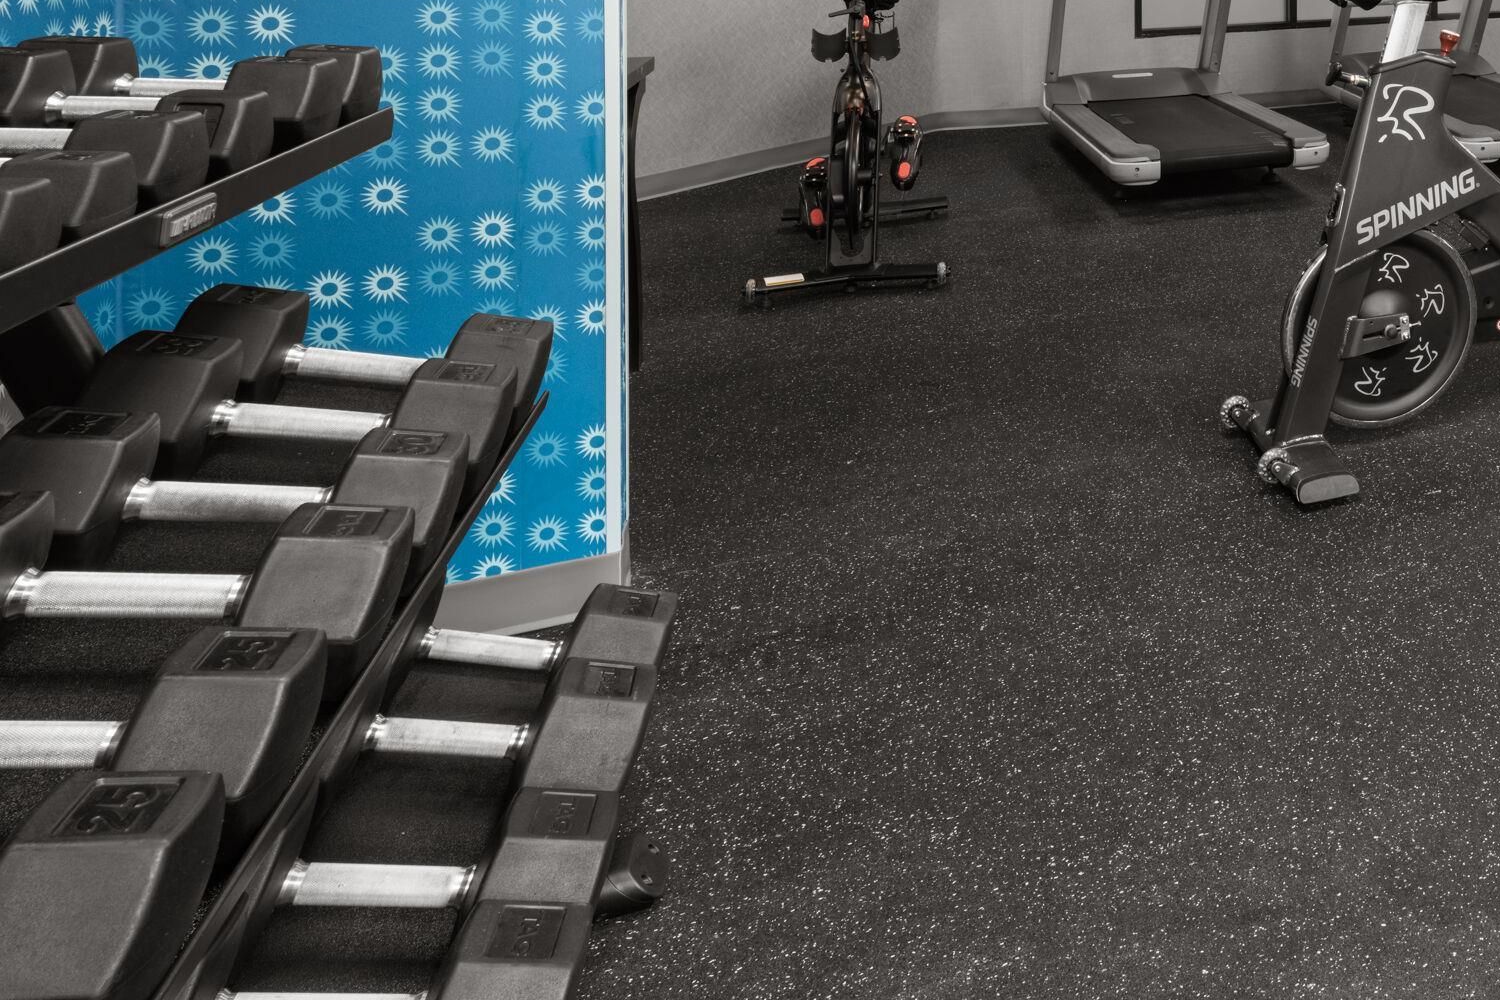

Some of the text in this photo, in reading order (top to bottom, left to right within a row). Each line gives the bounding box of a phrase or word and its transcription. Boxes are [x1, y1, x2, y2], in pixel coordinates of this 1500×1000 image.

[1356, 167, 1475, 246] SPINNING
[1290, 315, 1318, 388] SPINNING
[214, 638, 277, 670] 25
[77, 786, 161, 833] 25
